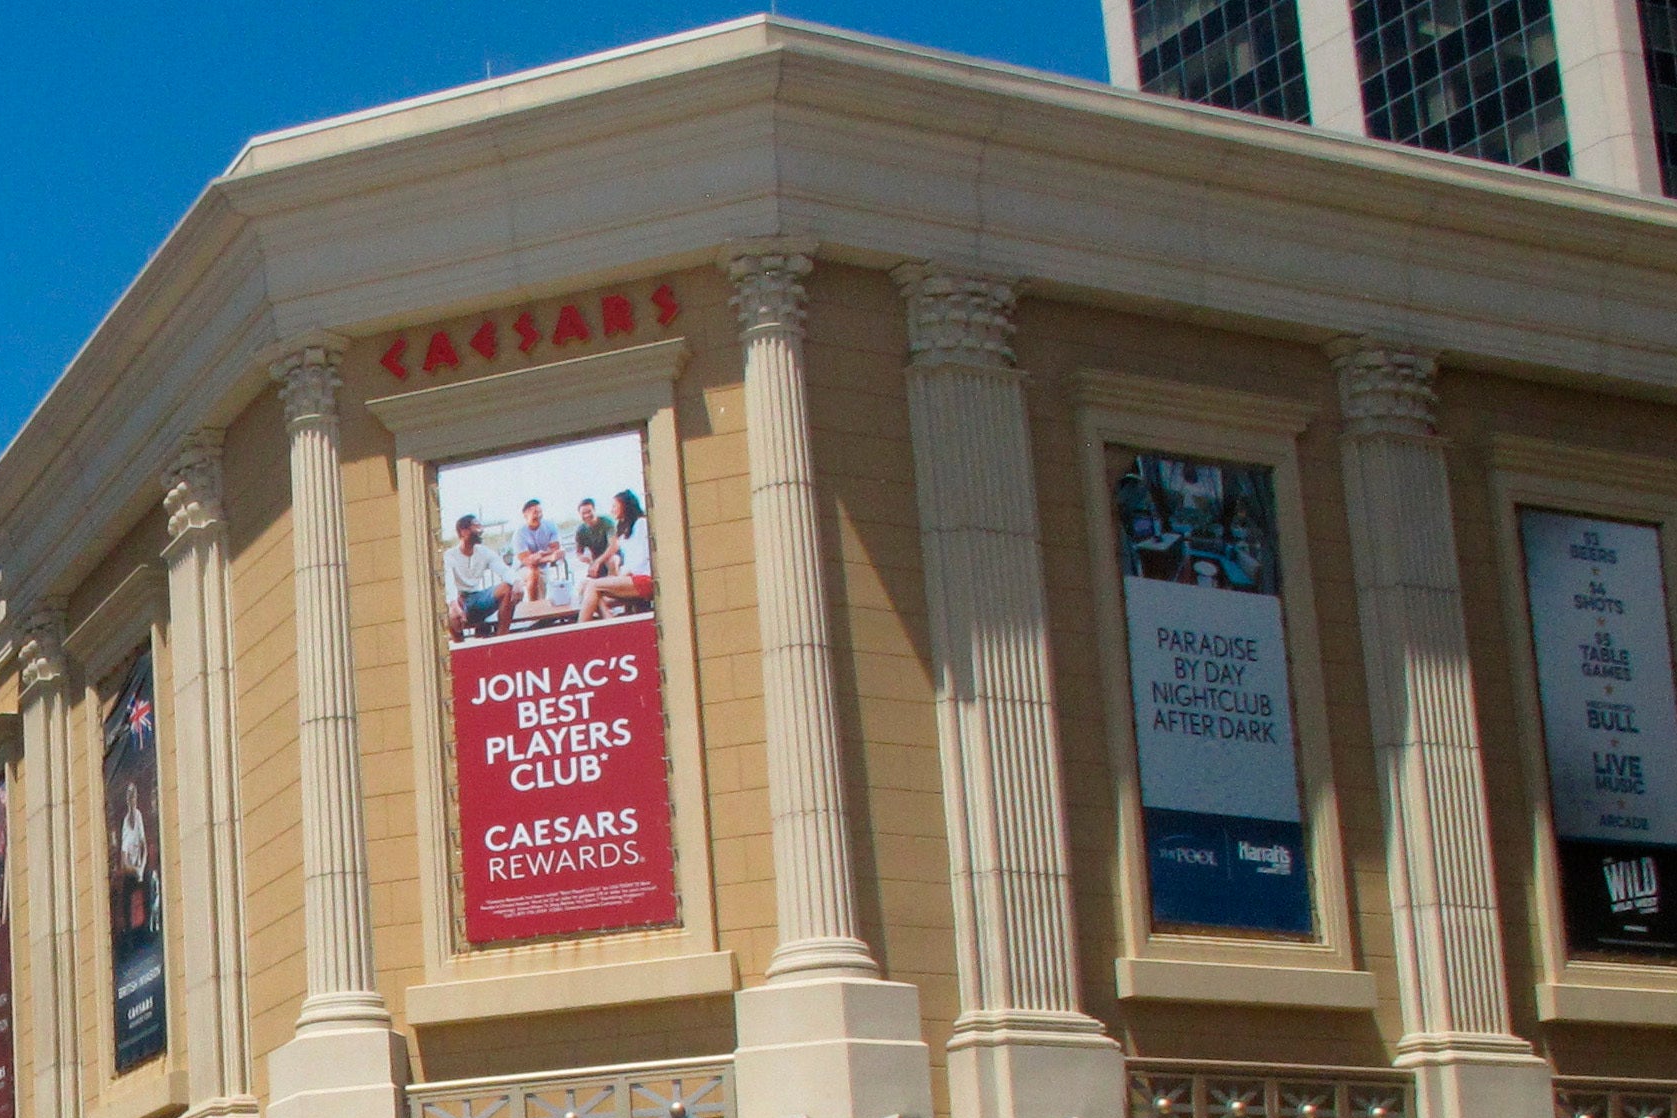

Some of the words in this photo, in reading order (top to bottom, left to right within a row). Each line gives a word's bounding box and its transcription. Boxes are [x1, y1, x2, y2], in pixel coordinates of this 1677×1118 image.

[379, 284, 679, 380] CAESARS
[1570, 544, 1617, 564] BEERS
[1574, 594, 1623, 614] SHOTS
[1157, 627, 1258, 662] PARADISE
[1578, 644, 1629, 666] TABLE
[471, 667, 551, 705] JOIN
[560, 654, 639, 691] AC'S
[1175, 657, 1200, 680] BY
[1205, 661, 1247, 686] DAY
[1581, 663, 1632, 681] GAMES
[518, 692, 594, 729] BEST
[1152, 681, 1272, 716] NIGHTCLUB
[1153, 709, 1214, 737] AFTER
[1219, 716, 1275, 744] DARK
[1587, 709, 1640, 734] BULL
[486, 718, 632, 764] PLAYERS
[1593, 751, 1642, 777] LIVE
[484, 808, 639, 851] CAESARS
[1176, 847, 1218, 867] POOL
